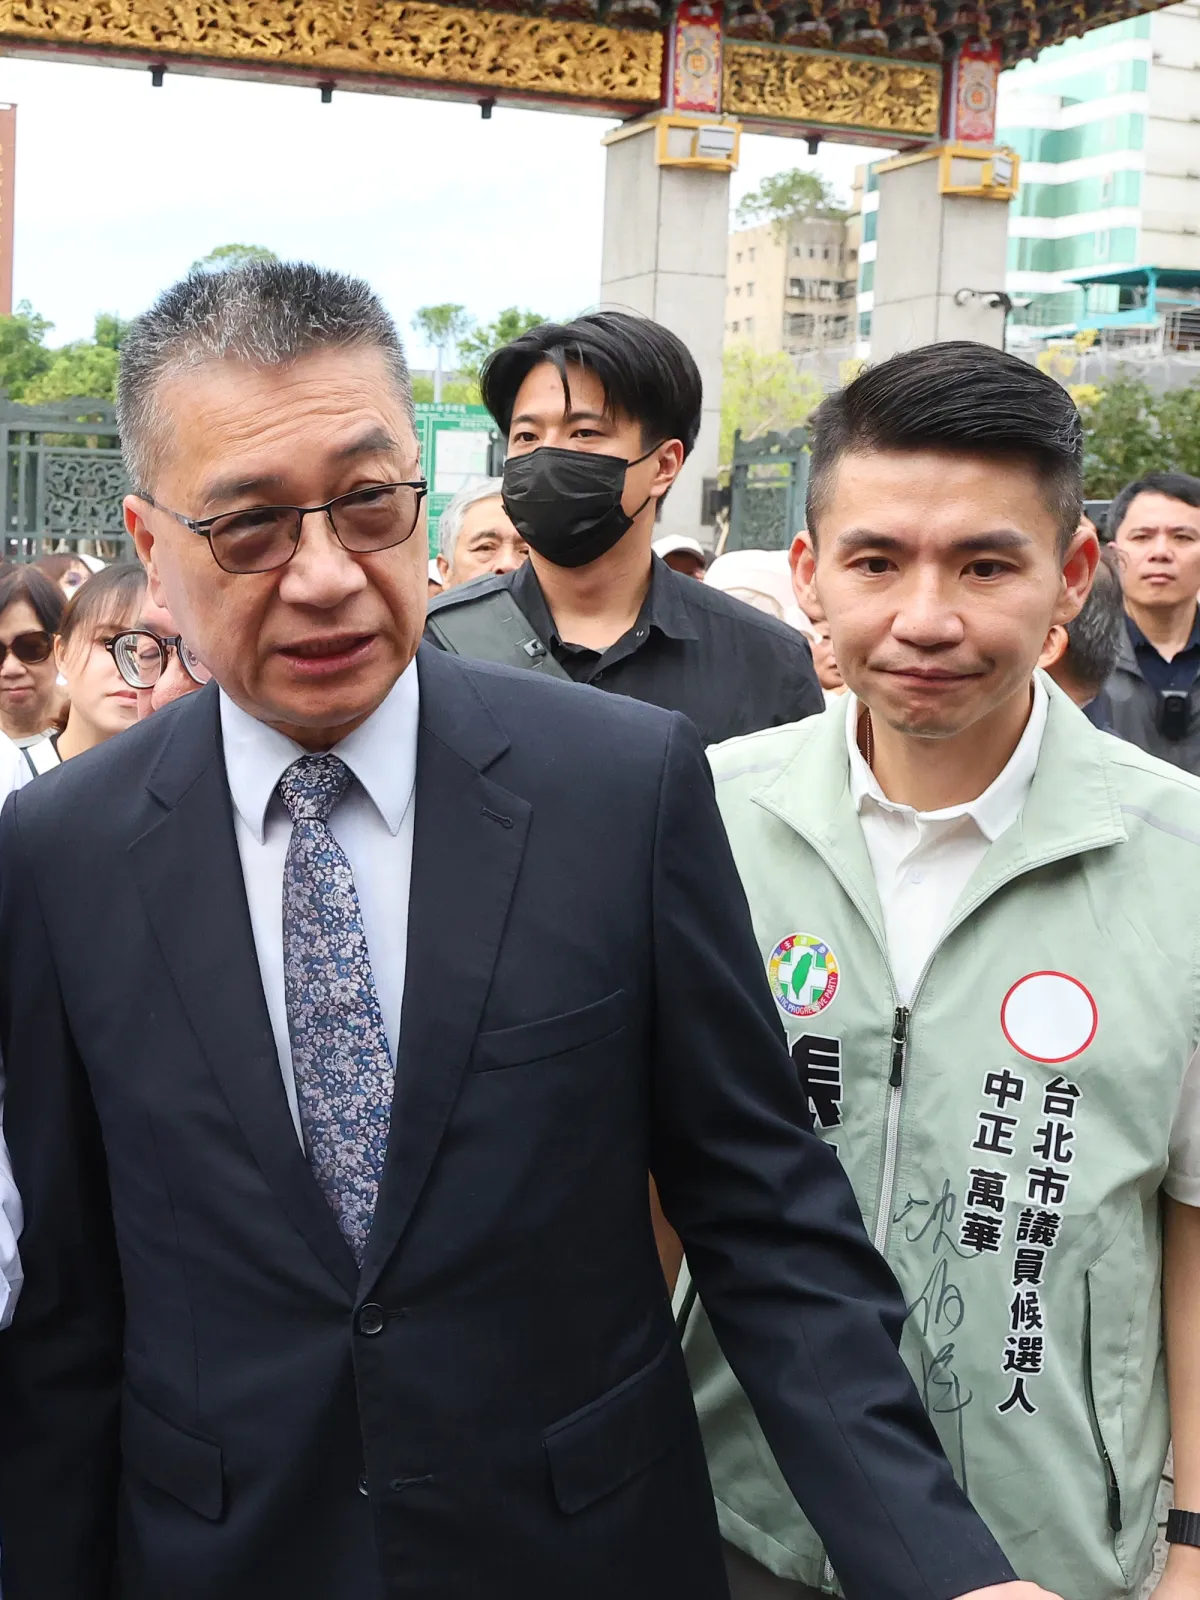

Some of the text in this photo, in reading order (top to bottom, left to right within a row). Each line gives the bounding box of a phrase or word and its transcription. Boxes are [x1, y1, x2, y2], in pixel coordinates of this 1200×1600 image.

[824, 975, 837, 999] PARTY
[998, 1077, 1081, 1414] 台北市議員候選人
